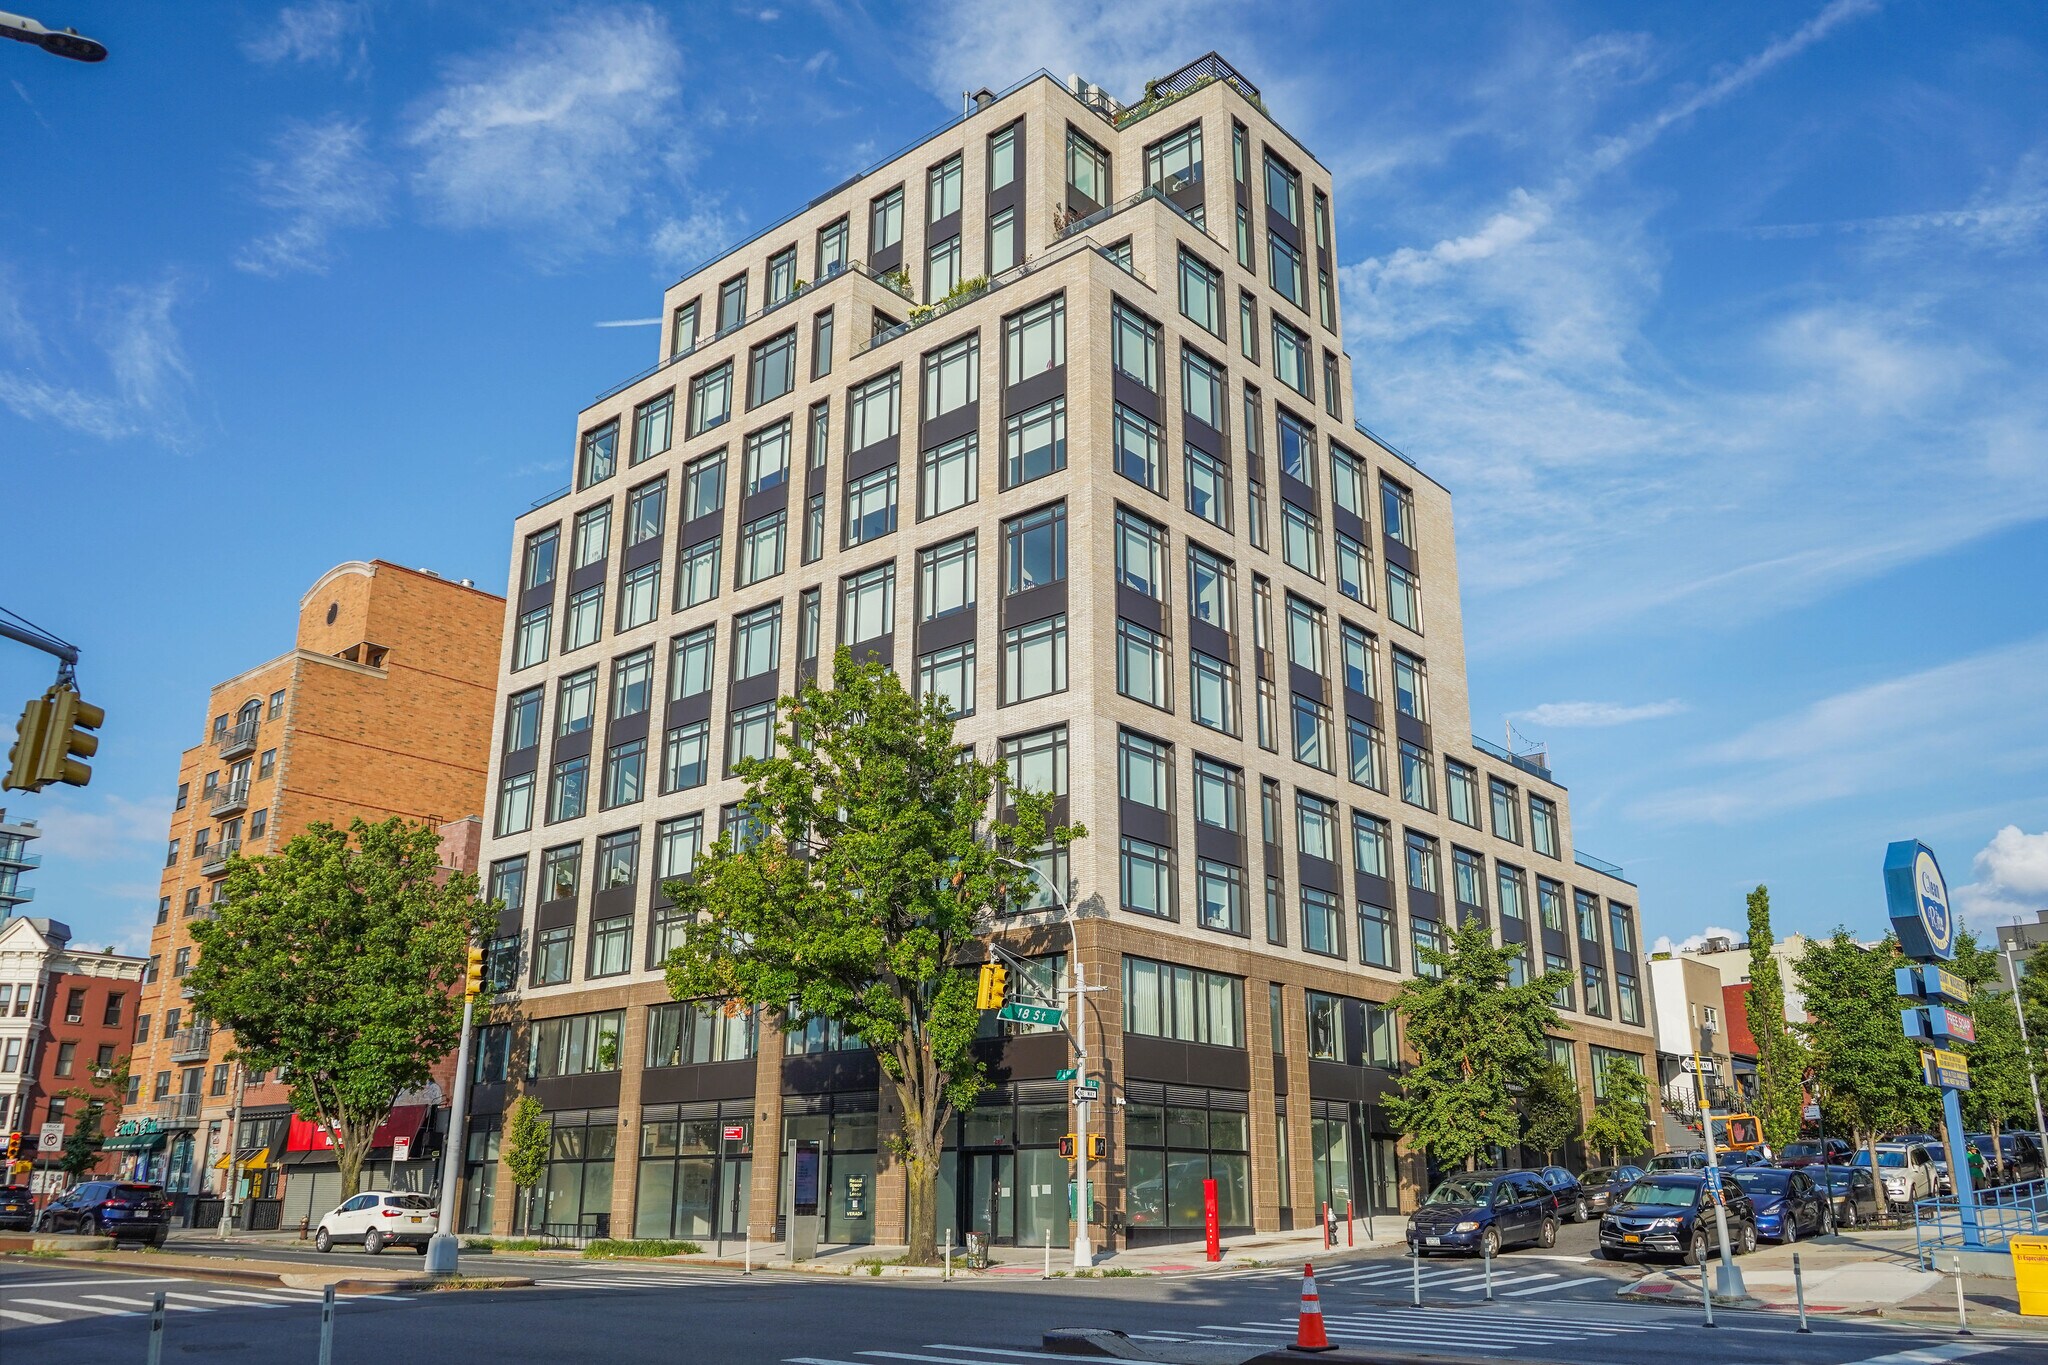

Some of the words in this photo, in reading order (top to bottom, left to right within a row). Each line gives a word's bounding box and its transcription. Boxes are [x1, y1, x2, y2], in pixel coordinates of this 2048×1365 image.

[1922, 871, 1940, 900] Clean
[1017, 1007, 1030, 1019] 18
[1033, 1010, 1046, 1022] St
[1946, 1012, 1958, 1027] FREE
[1958, 1017, 1970, 1031] SOAP
[1685, 1060, 1695, 1069] ONE
[1700, 1062, 1710, 1070] WAY
